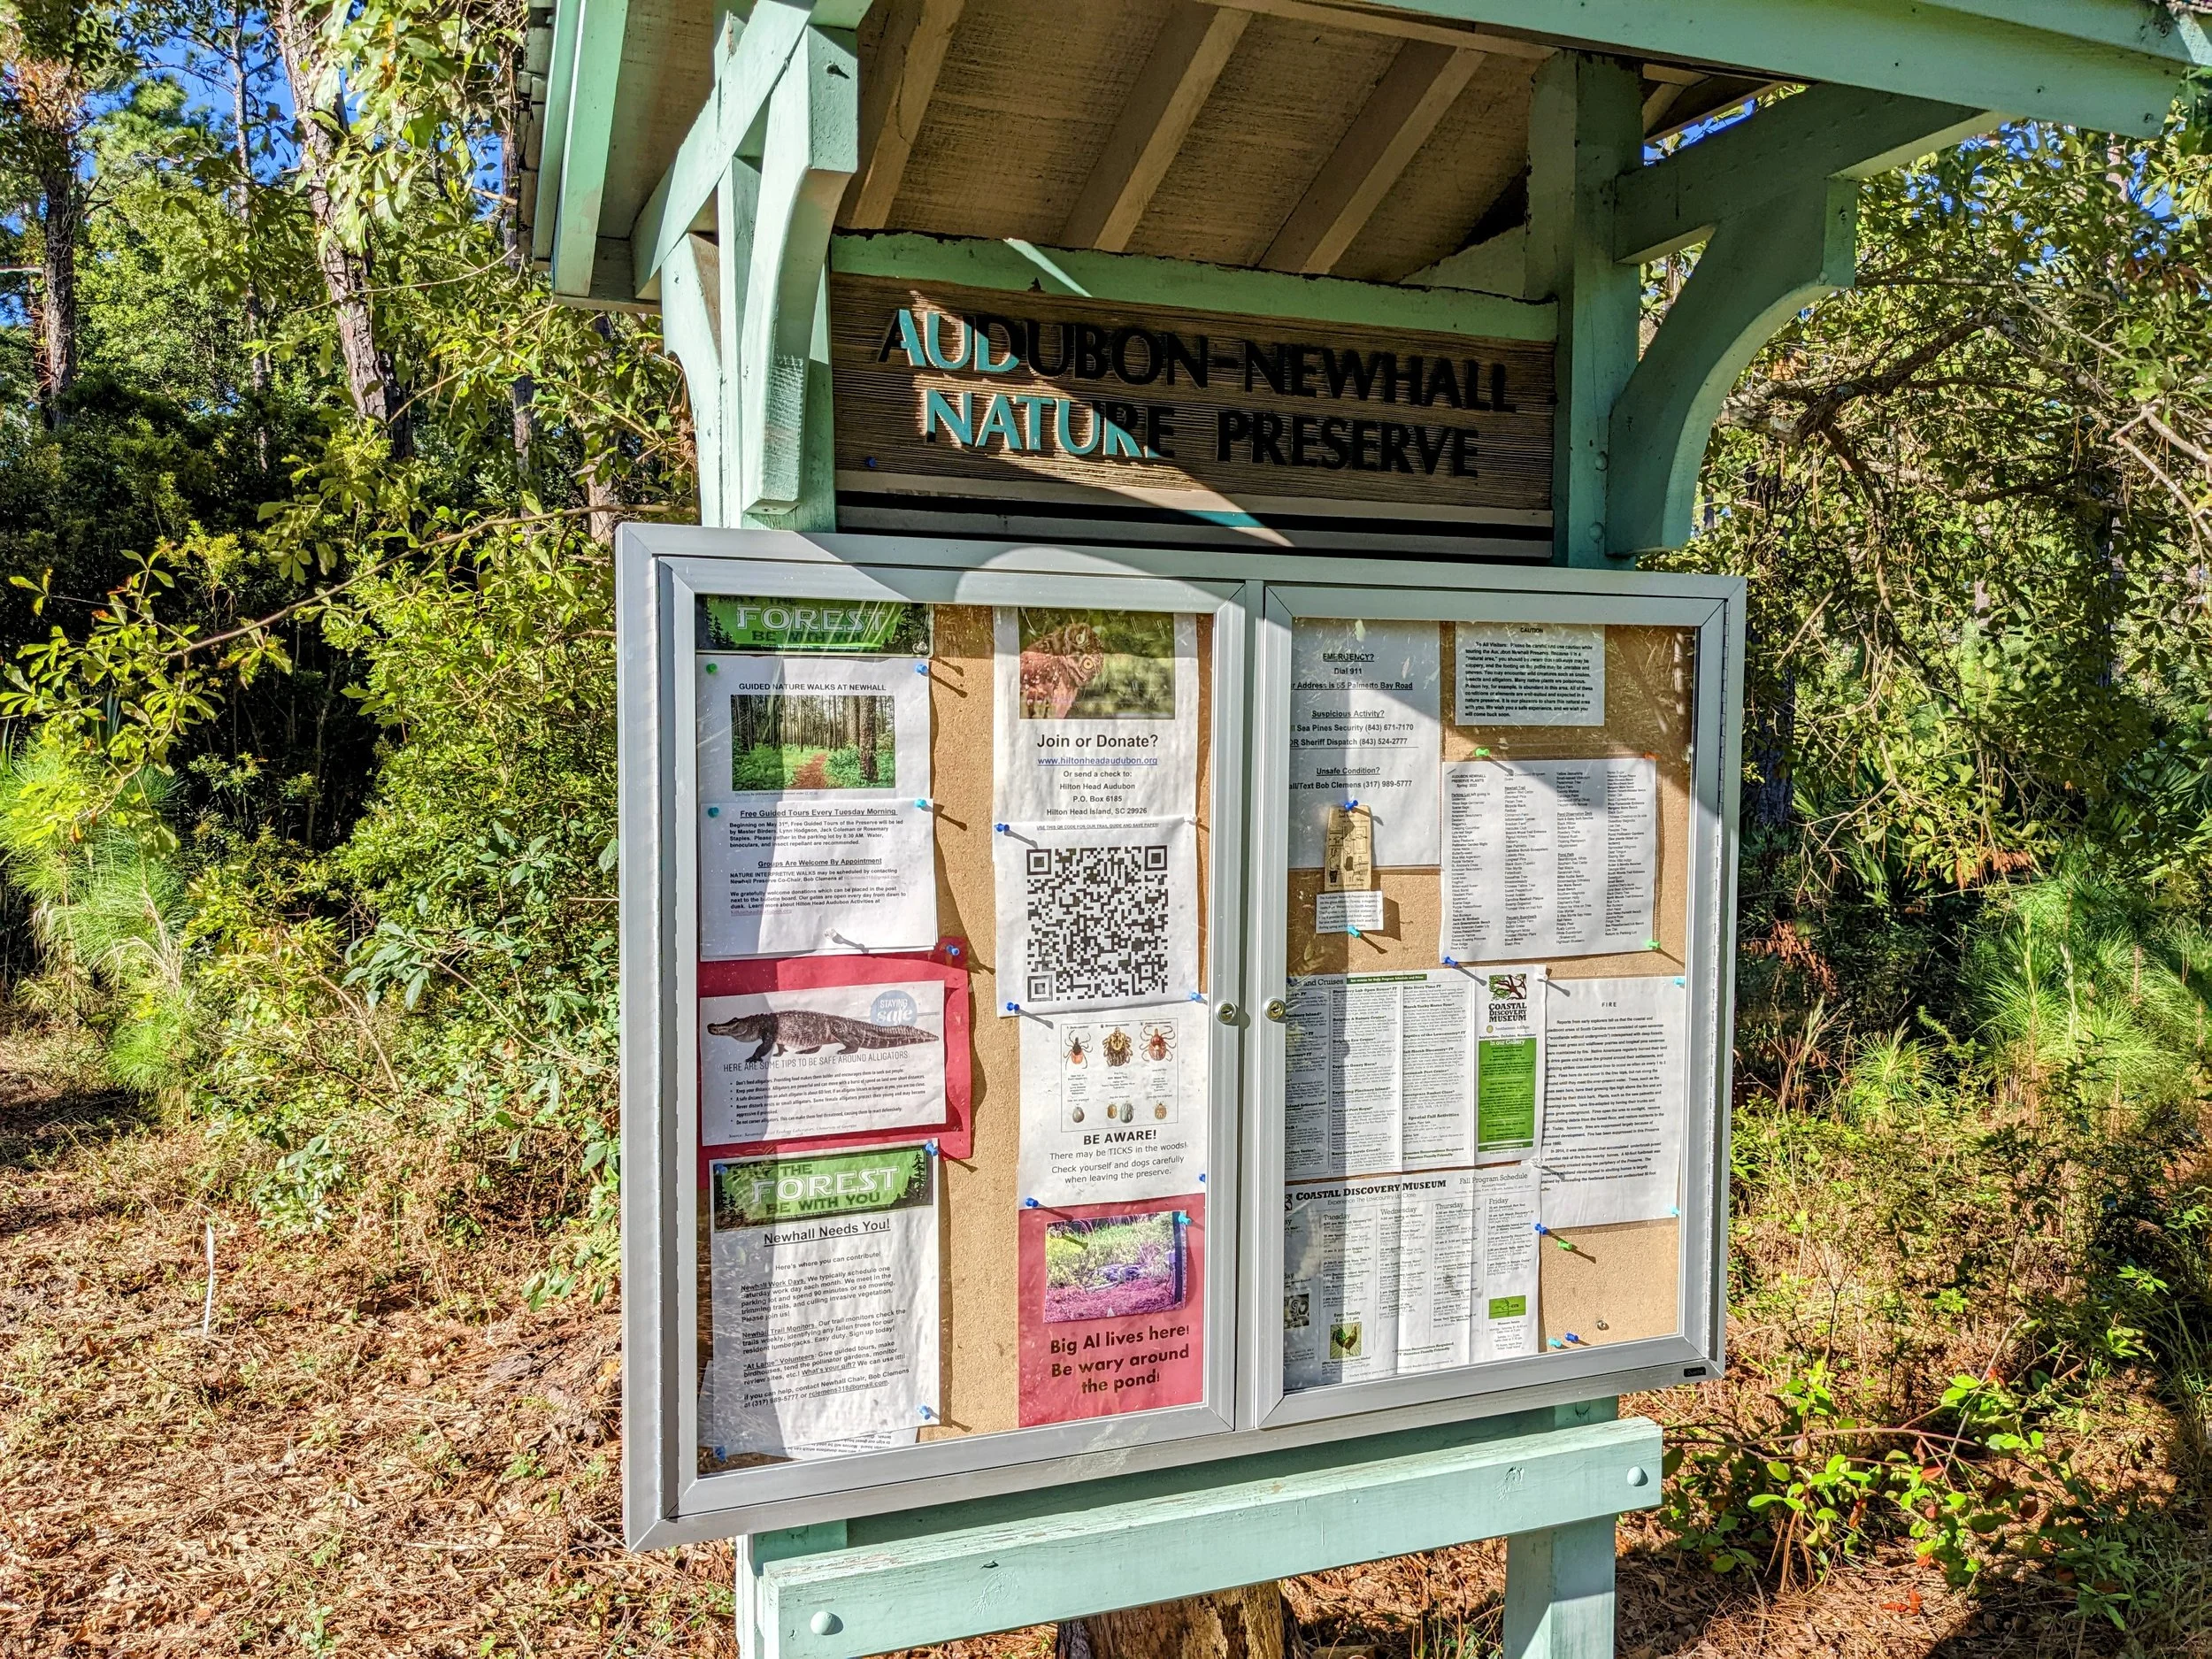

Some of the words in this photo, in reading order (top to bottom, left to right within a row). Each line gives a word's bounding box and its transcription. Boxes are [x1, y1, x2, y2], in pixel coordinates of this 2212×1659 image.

[878, 308, 1517, 413] AUDUBON-NEWHALL
[924, 388, 1176, 459] NATURE
[1217, 411, 1479, 479] PRESERVE
[736, 604, 888, 634] FOREST
[751, 630, 777, 641] BE
[1311, 710, 1351, 719] Suspicious
[1333, 724, 1363, 733] Security
[1364, 724, 1382, 733] (843)
[1036, 734, 1070, 747] Join
[1075, 737, 1091, 747] or
[1096, 734, 1158, 747] Donate?
[1326, 738, 1357, 748] Dispatch
[1358, 738, 1376, 747] (843)
[1363, 780, 1380, 789] (317)
[810, 809, 833, 818] Every
[866, 808, 896, 817] Morning
[879, 997, 908, 1009] STAYING
[877, 1007, 913, 1024] safe
[1488, 1014, 1527, 1023] MUSEUM
[723, 1062, 741, 1072] HERE
[743, 1061, 757, 1071] ARE
[759, 1059, 780, 1070] SOME
[781, 1058, 796, 1068] TIPS
[798, 1057, 807, 1067] TO
[808, 1056, 817, 1066] BE
[818, 1056, 836, 1065] SAFE
[837, 1054, 866, 1064] AROUND
[1083, 1134, 1100, 1145] BE
[1103, 1130, 1156, 1144] AWARE!
[1048, 1150, 1073, 1161] There
[1075, 1150, 1093, 1160] may
[1095, 1148, 1106, 1156] be
[1107, 1146, 1133, 1156] TICKS
[1135, 1145, 1142, 1154] in
[1144, 1144, 1157, 1153] the
[780, 1163, 813, 1176] THE
[1051, 1164, 1076, 1174] Check
[1079, 1161, 1112, 1173] yourself
[1113, 1160, 1128, 1169] and
[1131, 1158, 1149, 1170] dogs
[1151, 1155, 1184, 1168] carefully
[1064, 1174, 1087, 1184] when
[1089, 1171, 1118, 1184] leaving
[1120, 1171, 1133, 1179] the
[1135, 1169, 1171, 1179] preserve.
[1471, 1175, 1499, 1185] Program
[751, 1166, 900, 1204] FOREST
[1295, 1189, 1340, 1202] COASTAL
[1342, 1183, 1401, 1196] DISCOVERY
[1402, 1179, 1447, 1191] MUSEUM
[765, 1202, 791, 1215] BE
[799, 1198, 839, 1212] WITH
[845, 1192, 880, 1205] YOU
[1434, 1202, 1464, 1211] Thursday
[1488, 1197, 1509, 1206] Friday
[1323, 1212, 1351, 1221] Tuesday
[1379, 1206, 1417, 1216] Wednesday
[764, 1228, 815, 1244] Newhall
[818, 1223, 858, 1238] Needs
[863, 1218, 889, 1233] You!
[775, 1262, 796, 1271] Here's
[797, 1259, 818, 1268] where
[742, 1344, 769, 1355] resident
[771, 1338, 813, 1352] lumberjacks.
[814, 1335, 830, 1345] Easy
[831, 1333, 848, 1343] duty.
[849, 1331, 864, 1340] Sign
[1050, 1338, 1077, 1356] Big
[1082, 1333, 1100, 1350] Al
[1105, 1330, 1143, 1347] lives
[1148, 1325, 1189, 1341] here!
[1051, 1363, 1072, 1378] Be
[1078, 1356, 1125, 1373] wary
[1129, 1343, 1189, 1367] around
[1081, 1378, 1108, 1394] the
[1113, 1368, 1160, 1394] pond!
[751, 1398, 768, 1408] (317)
